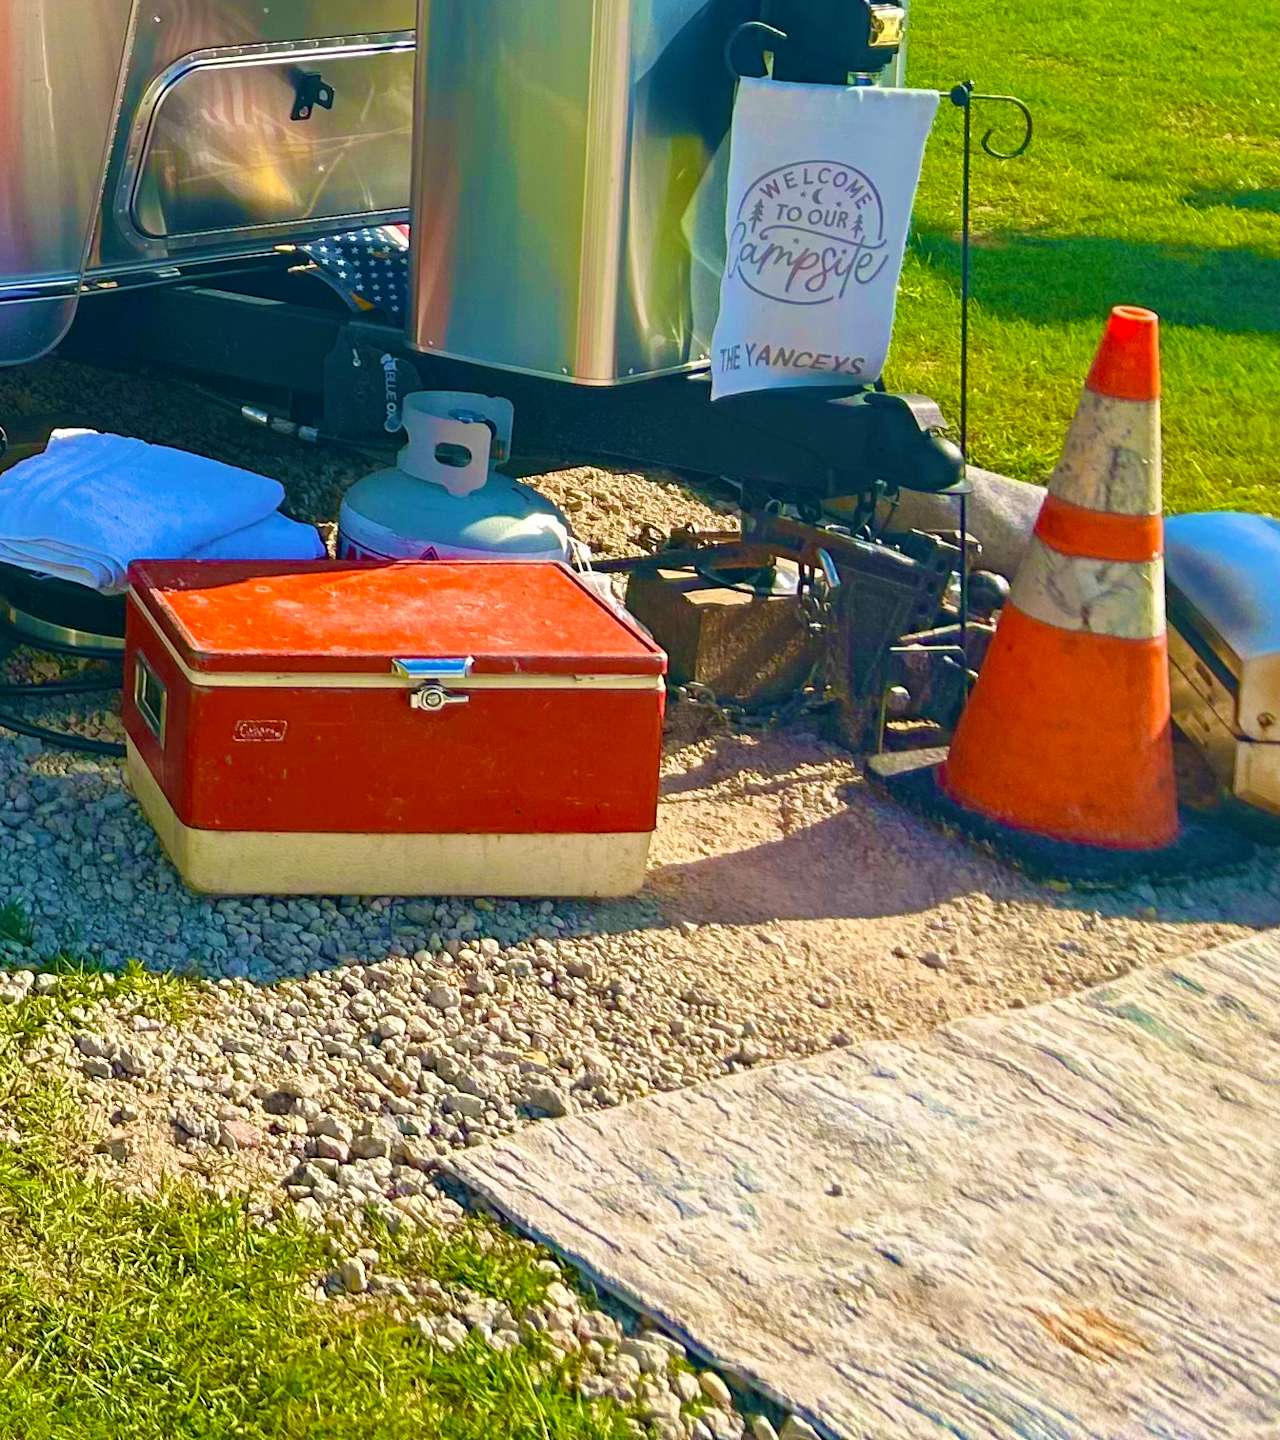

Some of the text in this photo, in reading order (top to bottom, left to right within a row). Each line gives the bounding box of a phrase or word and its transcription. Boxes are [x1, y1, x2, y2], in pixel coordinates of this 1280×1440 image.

[759, 167, 873, 211] WELCOME
[776, 203, 849, 229] TO OUR
[727, 221, 889, 299] Campsite
[719, 342, 865, 376] THE YANCEYS
